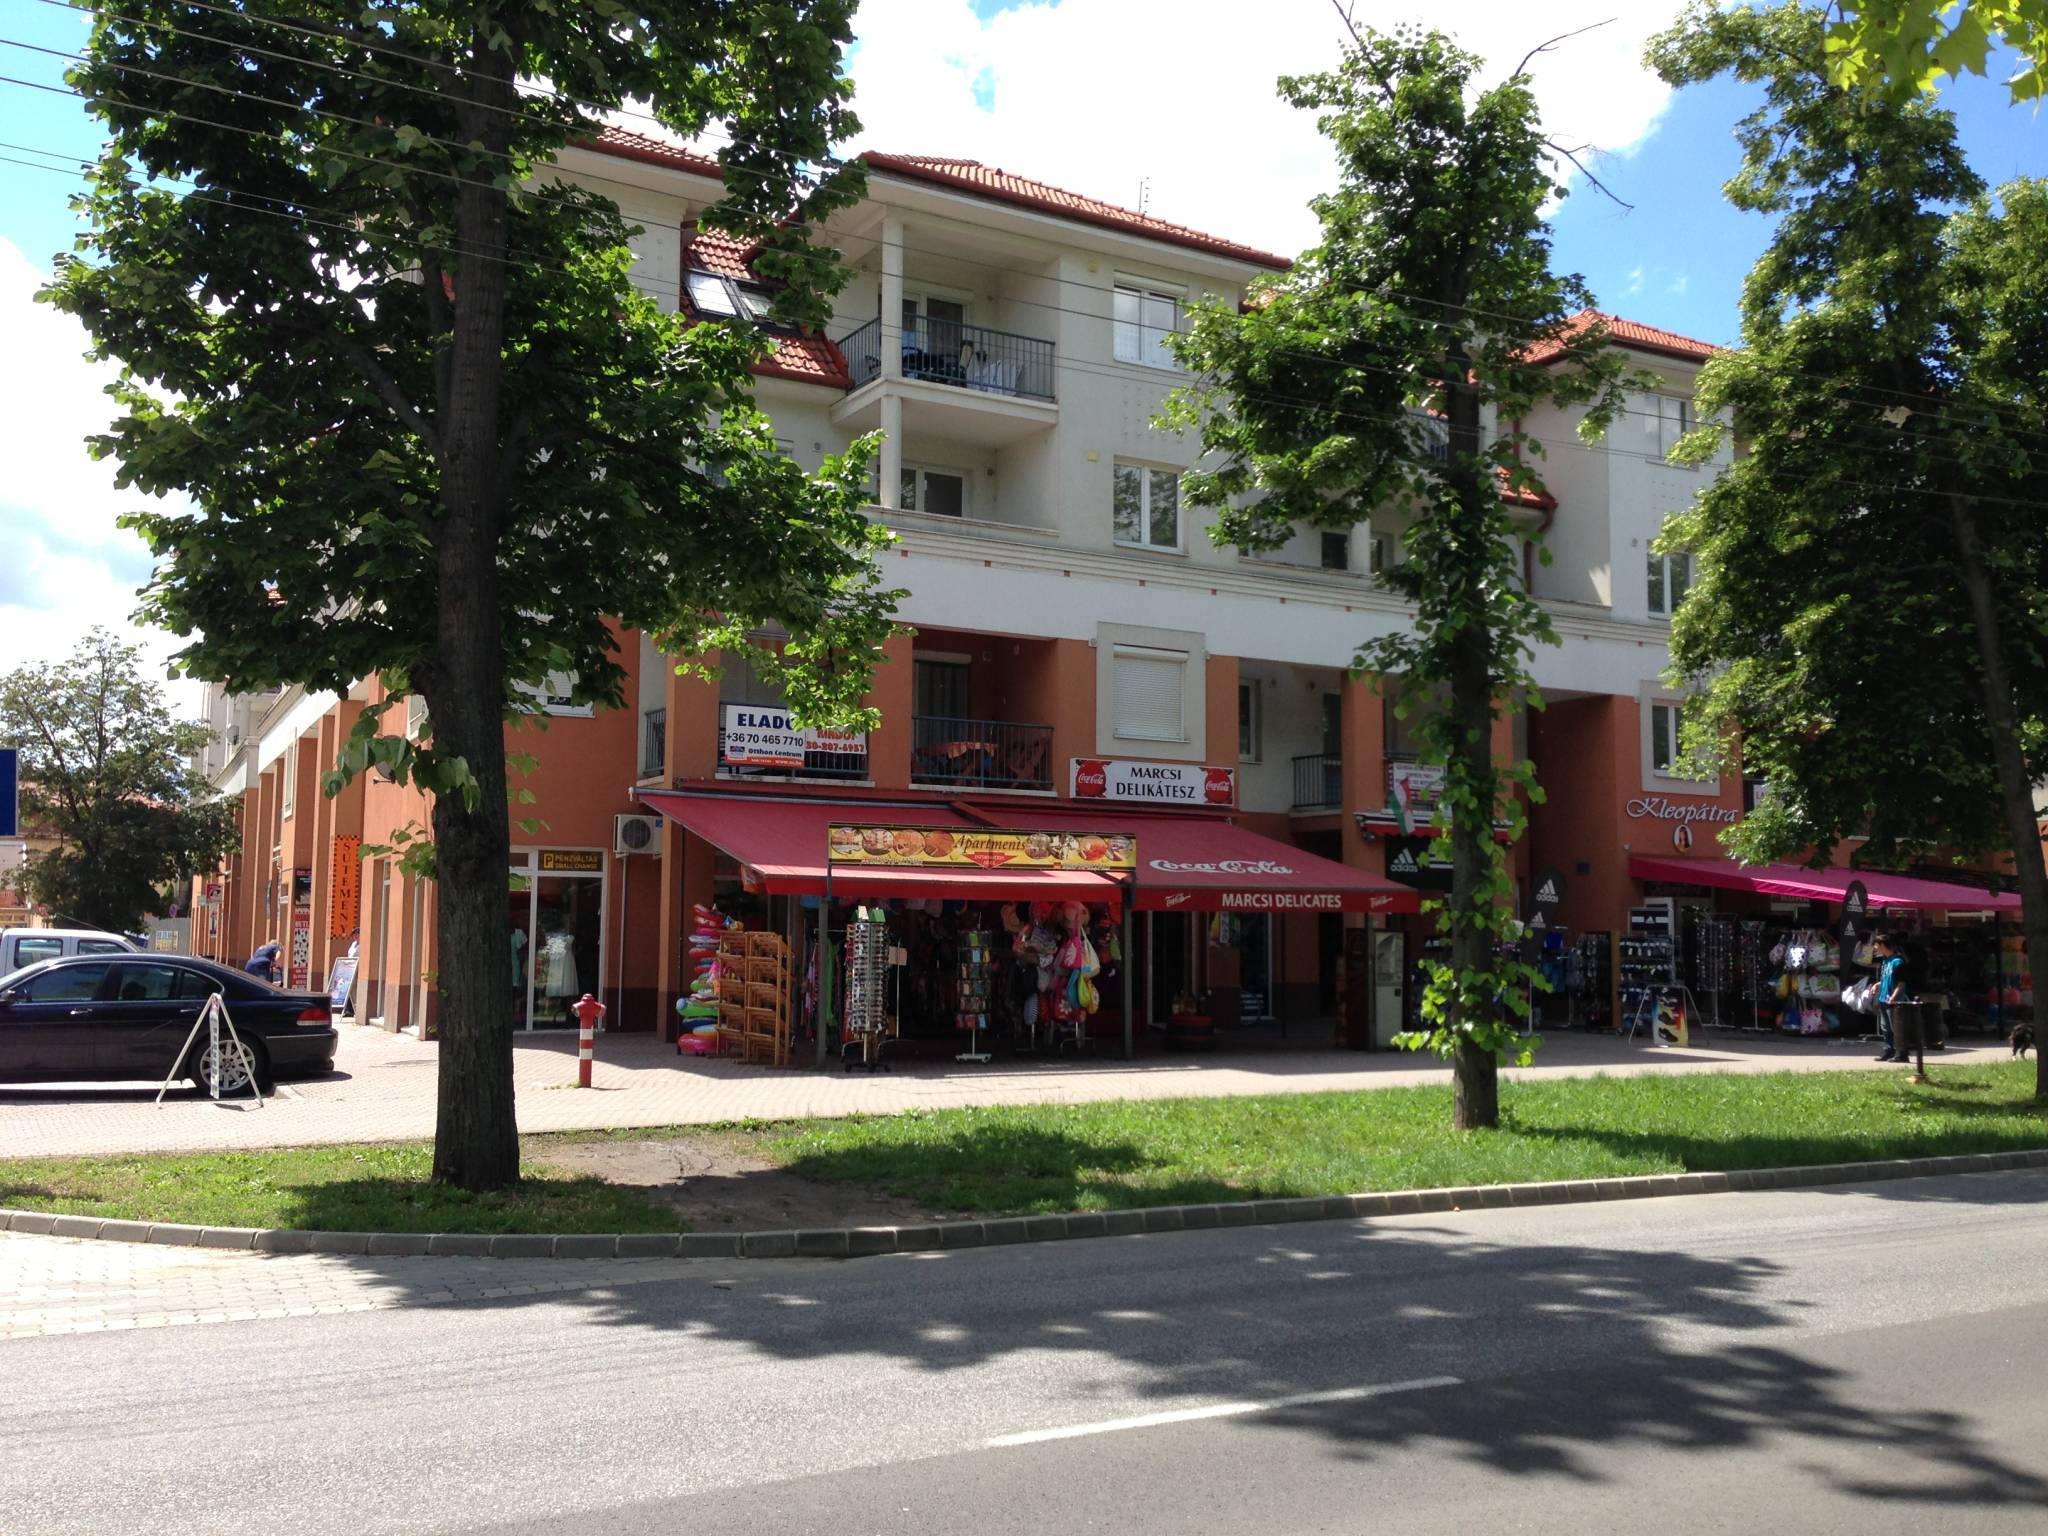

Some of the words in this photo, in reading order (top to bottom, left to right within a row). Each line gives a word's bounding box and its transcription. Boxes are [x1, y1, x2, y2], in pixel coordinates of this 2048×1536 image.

[726, 733, 745, 743] +36
[747, 734, 759, 744] 70
[762, 734, 781, 745] 465
[783, 736, 804, 747] 7710
[1131, 767, 1182, 780] MARCSI
[1116, 781, 1196, 799] DELIKÁTESZ
[1626, 797, 1739, 824] Kleopátra
[953, 833, 1025, 854] Apartments
[1390, 864, 1419, 873] adidas
[1221, 893, 1273, 908] MARCSI
[1276, 893, 1342, 909] DELICATES
